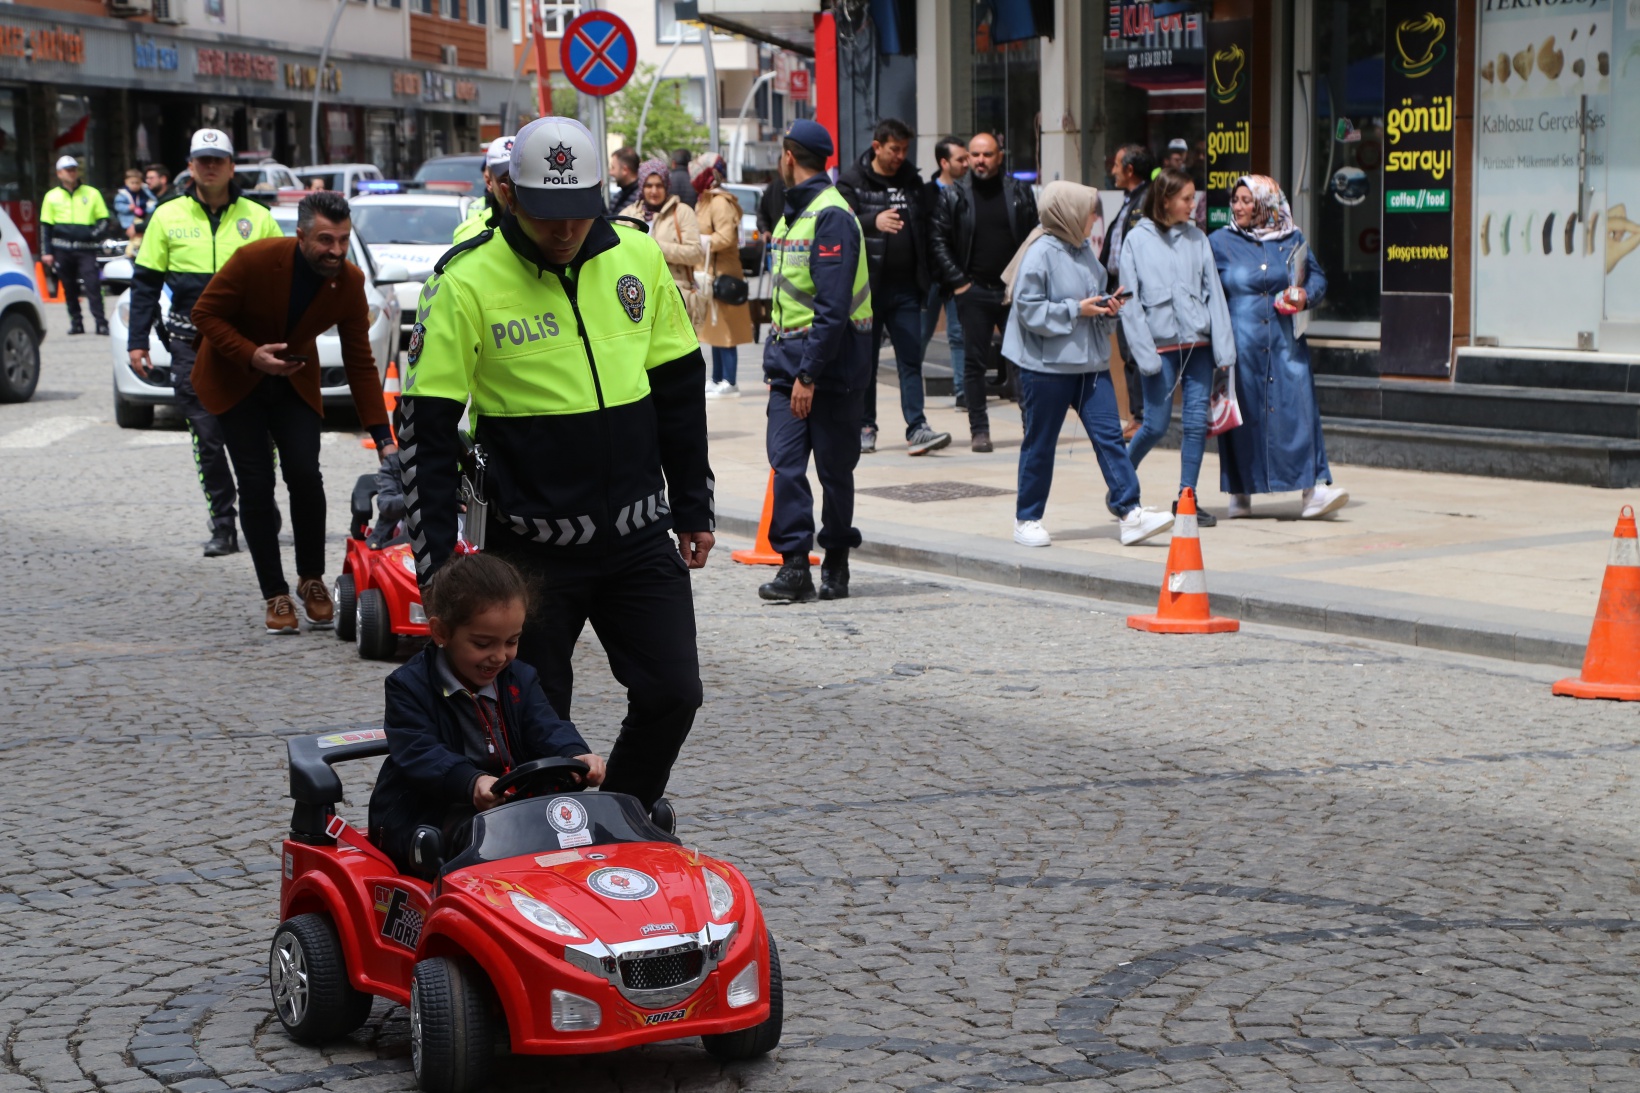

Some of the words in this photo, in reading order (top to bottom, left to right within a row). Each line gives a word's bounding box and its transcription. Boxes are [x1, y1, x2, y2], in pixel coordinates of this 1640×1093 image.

[1386, 95, 1452, 145] gönül
[1482, 113, 1534, 134] Kablosuz
[1538, 110, 1582, 133] Gerçek
[1586, 109, 1606, 129] Ses
[1207, 121, 1250, 165] gönül
[1385, 149, 1452, 180] sarayı
[1483, 155, 1515, 170] Pürüzsüz
[1517, 153, 1560, 168] Mükemmel
[1562, 153, 1575, 167] Ses
[1576, 152, 1605, 167] Klitesi
[1207, 170, 1249, 190] sara
[1390, 191, 1416, 207] coffee
[1426, 191, 1446, 207] food
[1210, 208, 1227, 223] coffee
